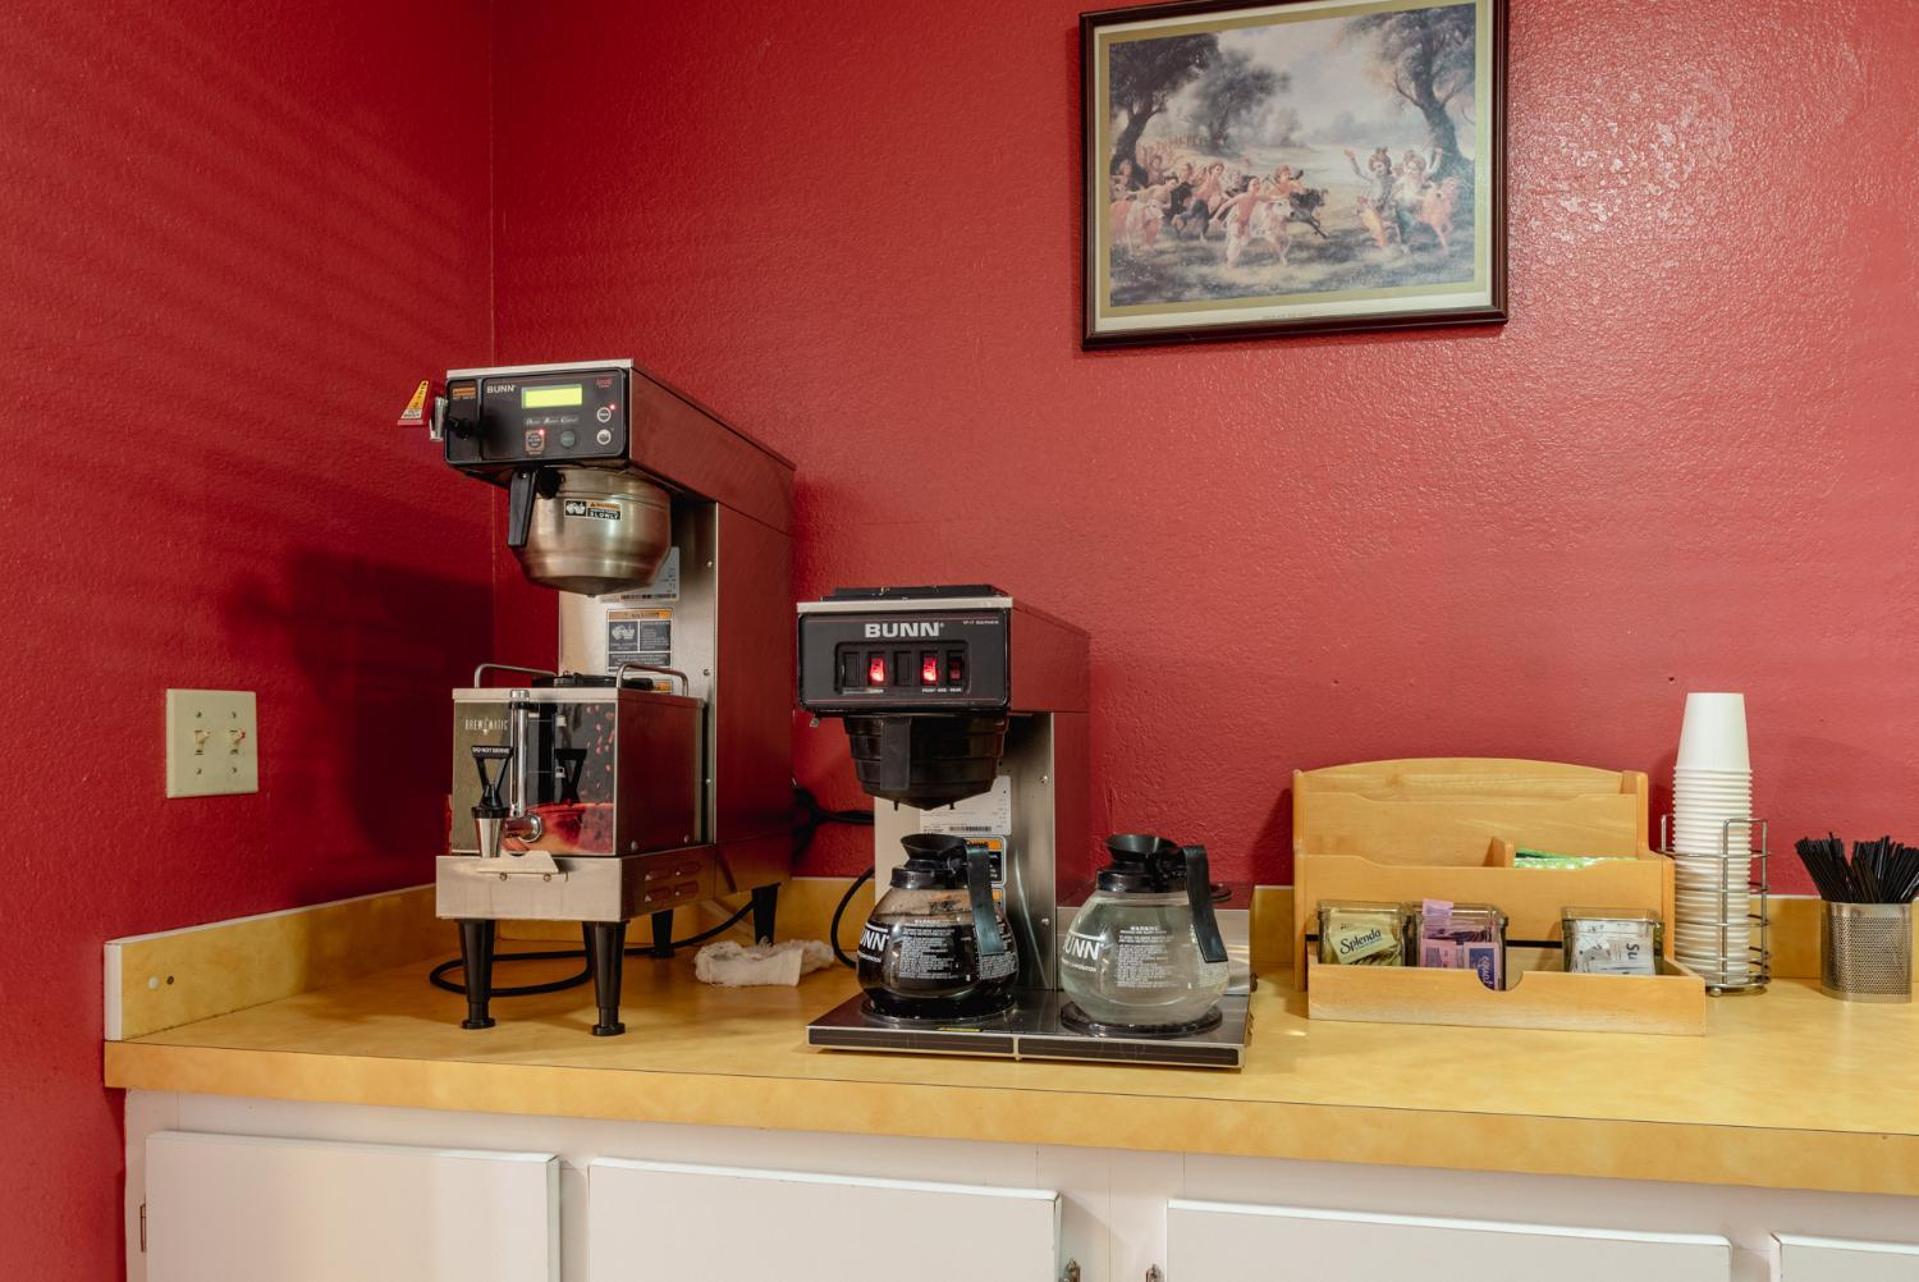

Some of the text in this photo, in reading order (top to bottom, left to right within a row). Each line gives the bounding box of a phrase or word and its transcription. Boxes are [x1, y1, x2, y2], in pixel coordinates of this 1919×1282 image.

[486, 384, 514, 394] BUNN
[864, 622, 940, 638] BUNN
[1340, 927, 1382, 955] Splenda
